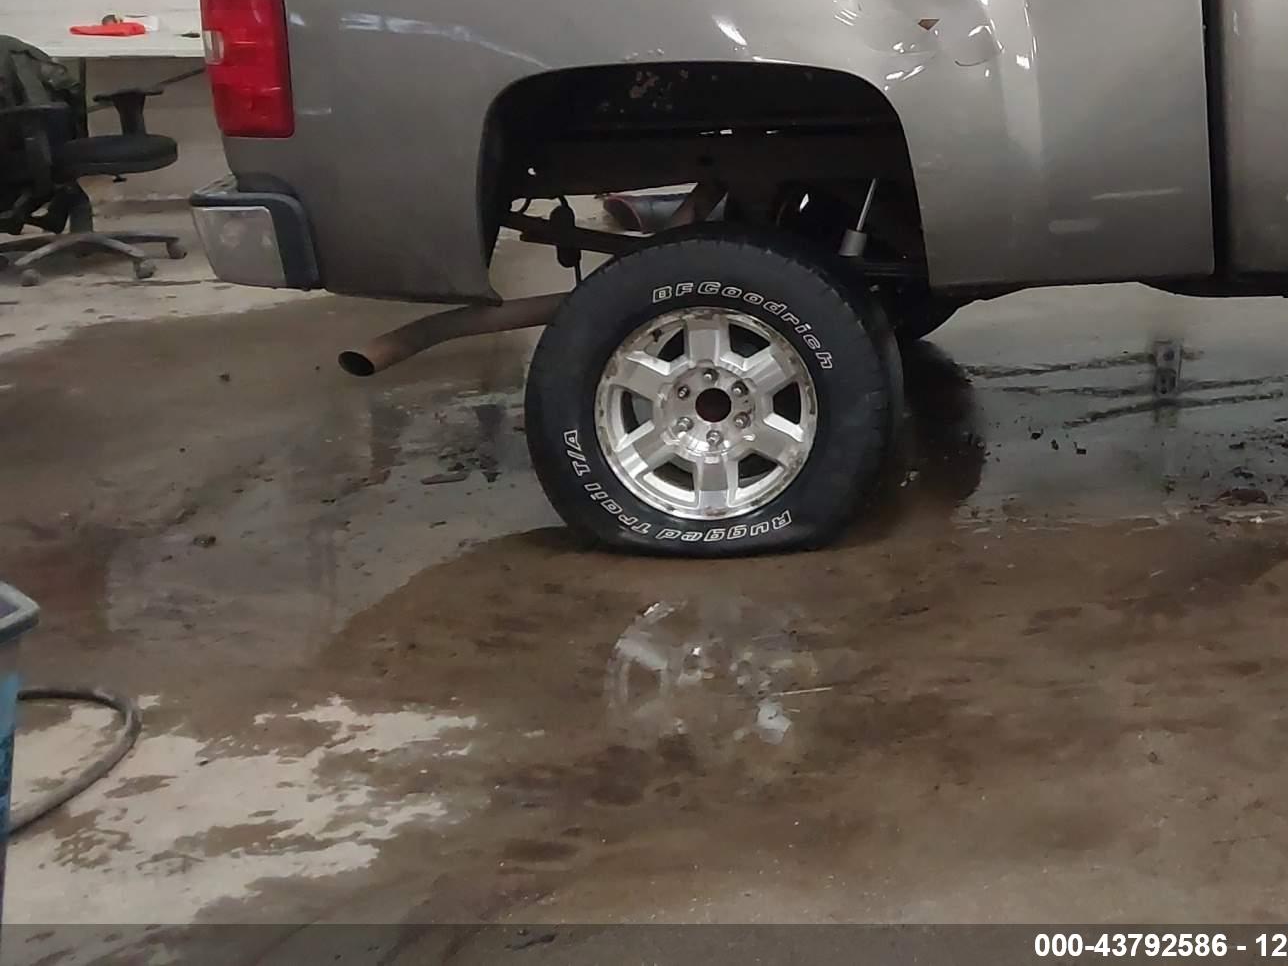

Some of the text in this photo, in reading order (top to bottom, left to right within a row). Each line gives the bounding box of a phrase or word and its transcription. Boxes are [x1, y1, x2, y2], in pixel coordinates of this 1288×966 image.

[652, 281, 833, 369] BFGoodrich
[563, 429, 793, 542] Rugged Trail T/A
